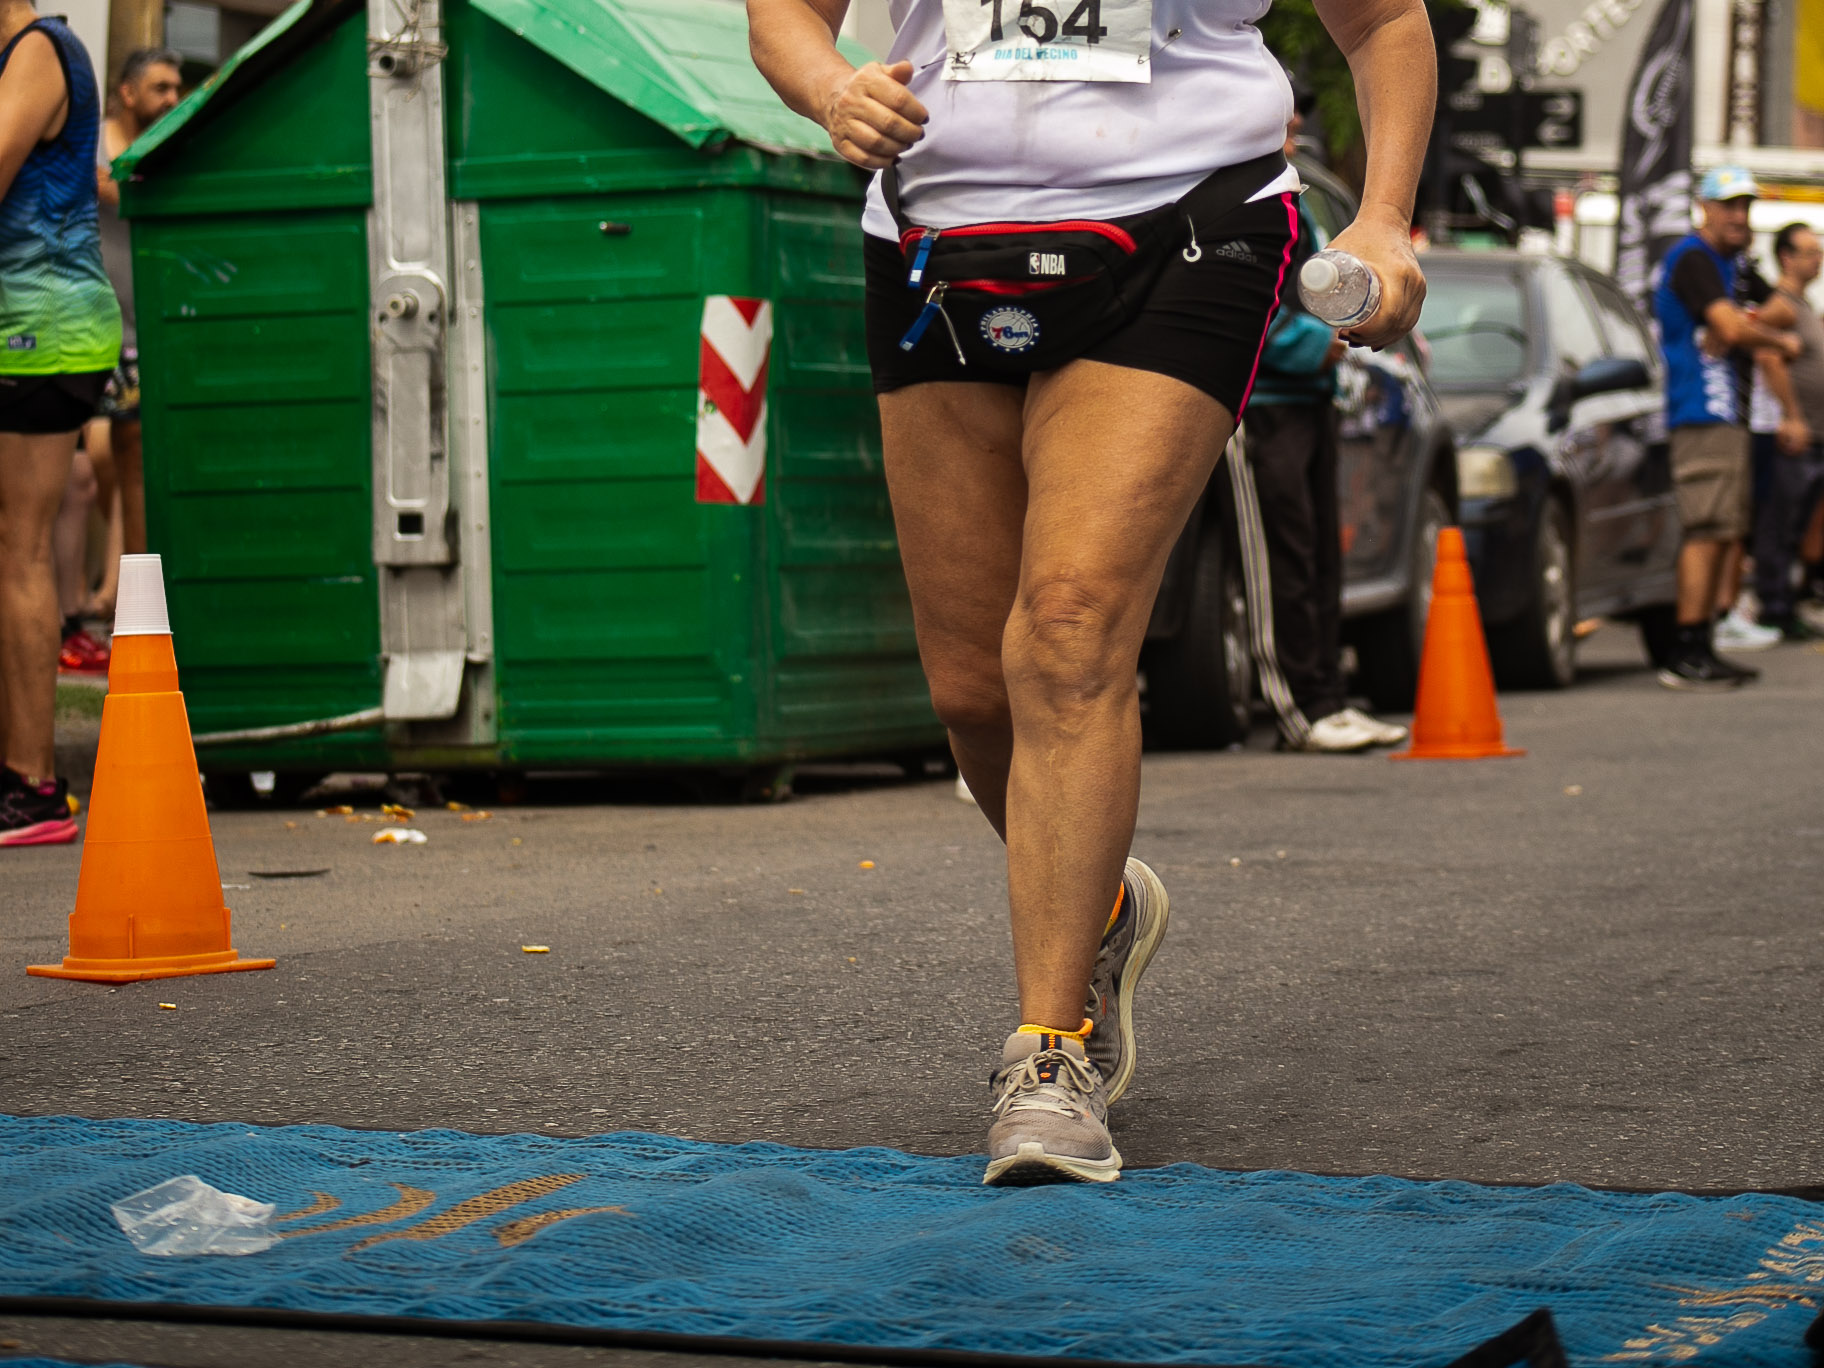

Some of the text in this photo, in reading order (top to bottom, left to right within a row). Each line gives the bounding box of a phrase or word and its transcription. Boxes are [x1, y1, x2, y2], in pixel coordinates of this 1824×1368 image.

[1014, 48, 1032, 60] DEL
[1036, 48, 1078, 61] VECINO
[1040, 252, 1066, 275] NBA
[1215, 248, 1258, 264] adidas
[980, 306, 1039, 331] PHILADELPHIA
[1048, 1033, 1056, 1049] NIK
